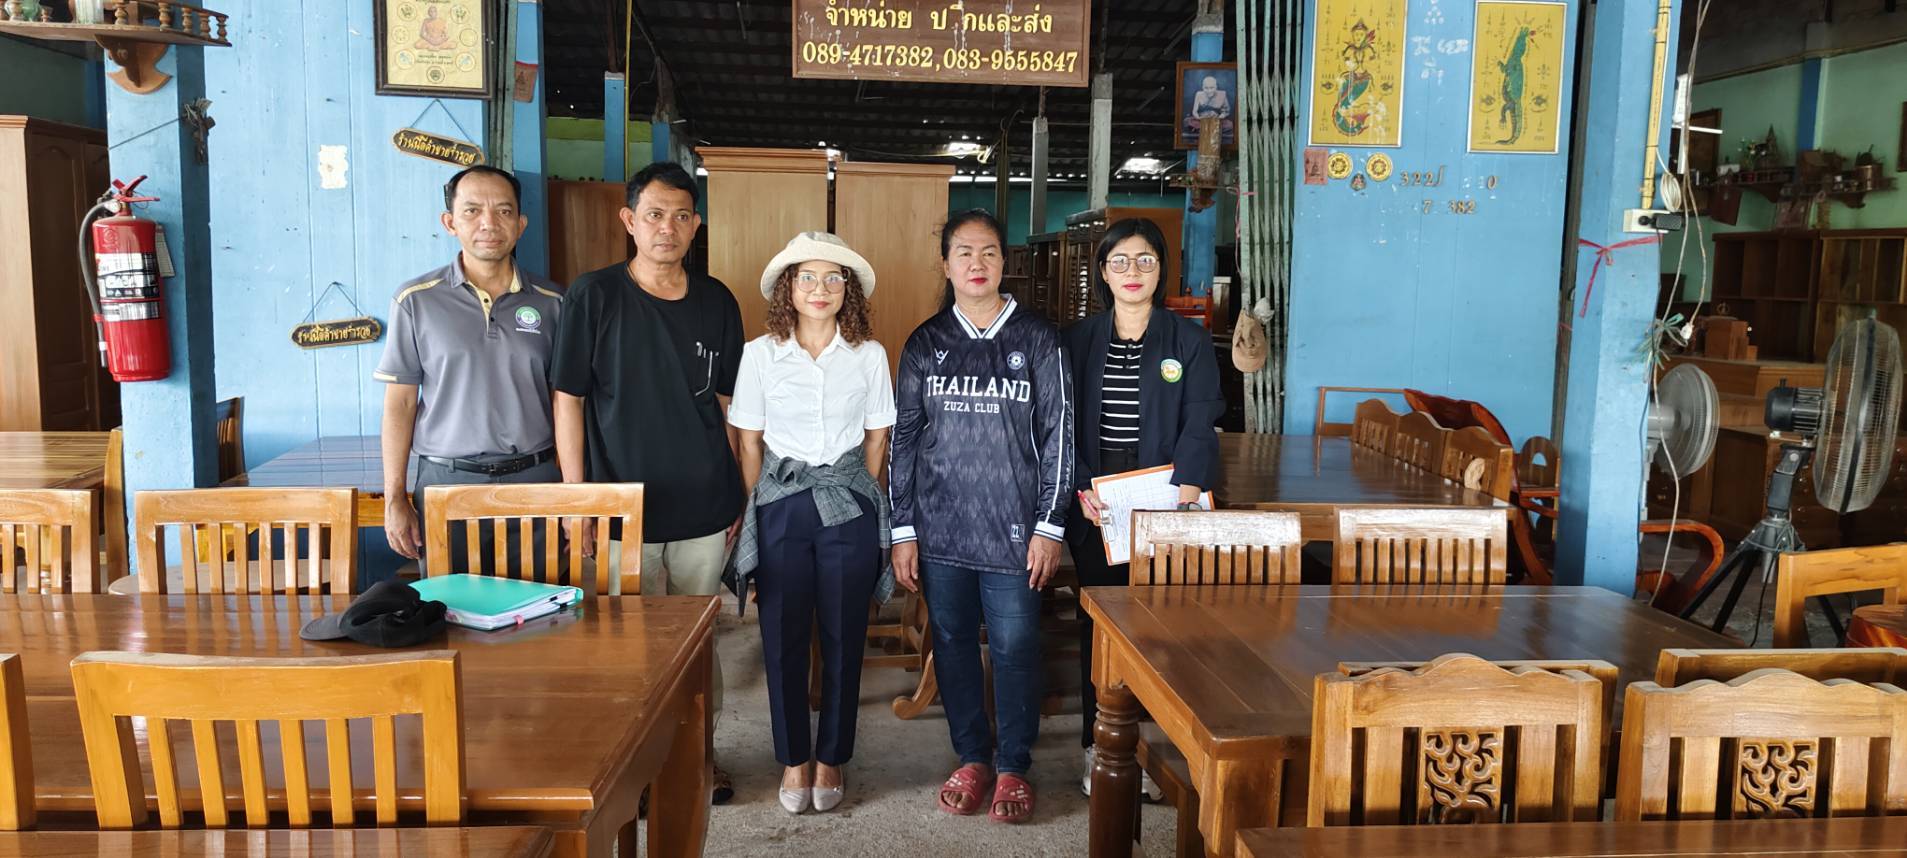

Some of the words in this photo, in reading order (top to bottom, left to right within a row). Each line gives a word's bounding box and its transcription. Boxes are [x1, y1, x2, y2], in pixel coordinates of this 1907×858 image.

[825, 0, 912, 30] จำหน่าย
[931, 2, 1053, 33] ปีกและส่ง
[926, 375, 1031, 403] THAILAND
[944, 400, 970, 413] ZUZA
[974, 402, 1000, 414] CLUB
